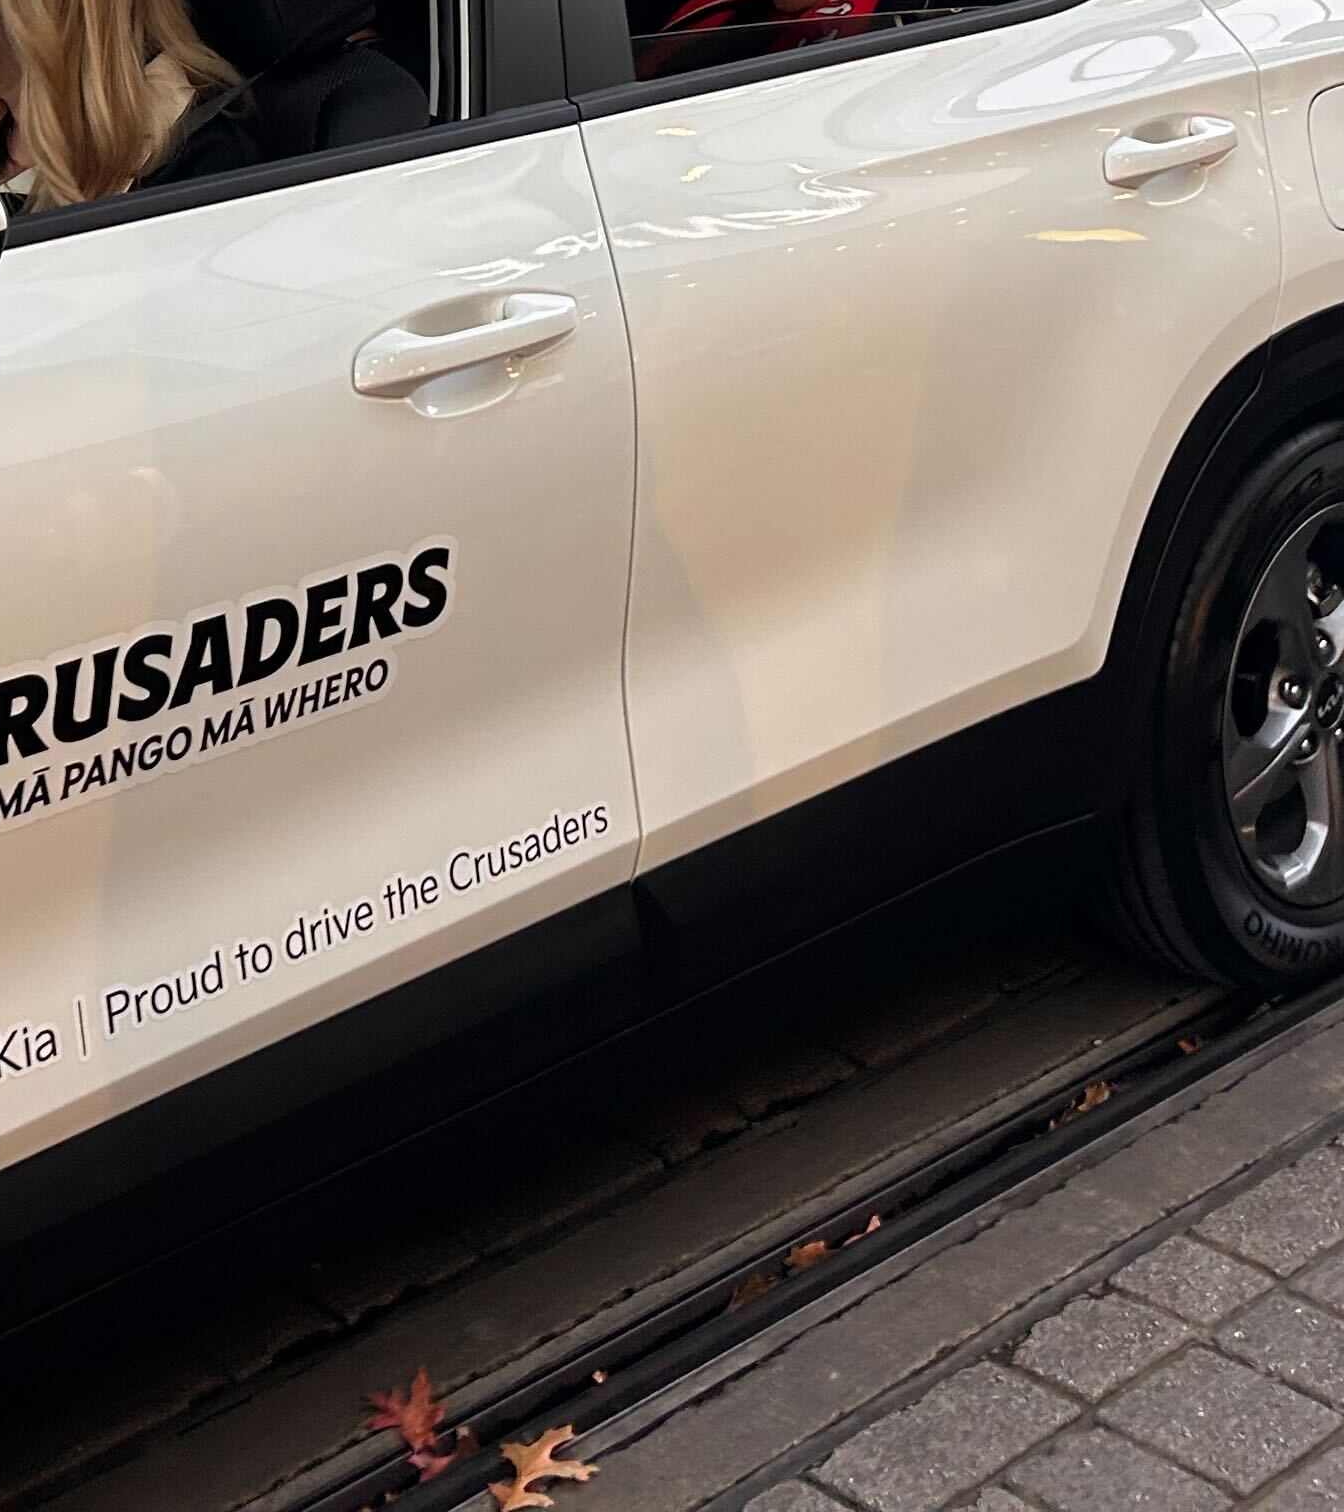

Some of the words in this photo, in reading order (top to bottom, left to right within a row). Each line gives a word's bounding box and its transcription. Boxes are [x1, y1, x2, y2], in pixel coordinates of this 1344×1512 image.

[60, 725, 193, 801] PANGO
[199, 700, 257, 752] MĀ
[263, 658, 389, 729] WHERO
[105, 953, 223, 1035] Proud
[234, 943, 273, 981] to
[285, 901, 374, 960] drive
[383, 875, 438, 920] the
[449, 805, 609, 891] Crusaders
